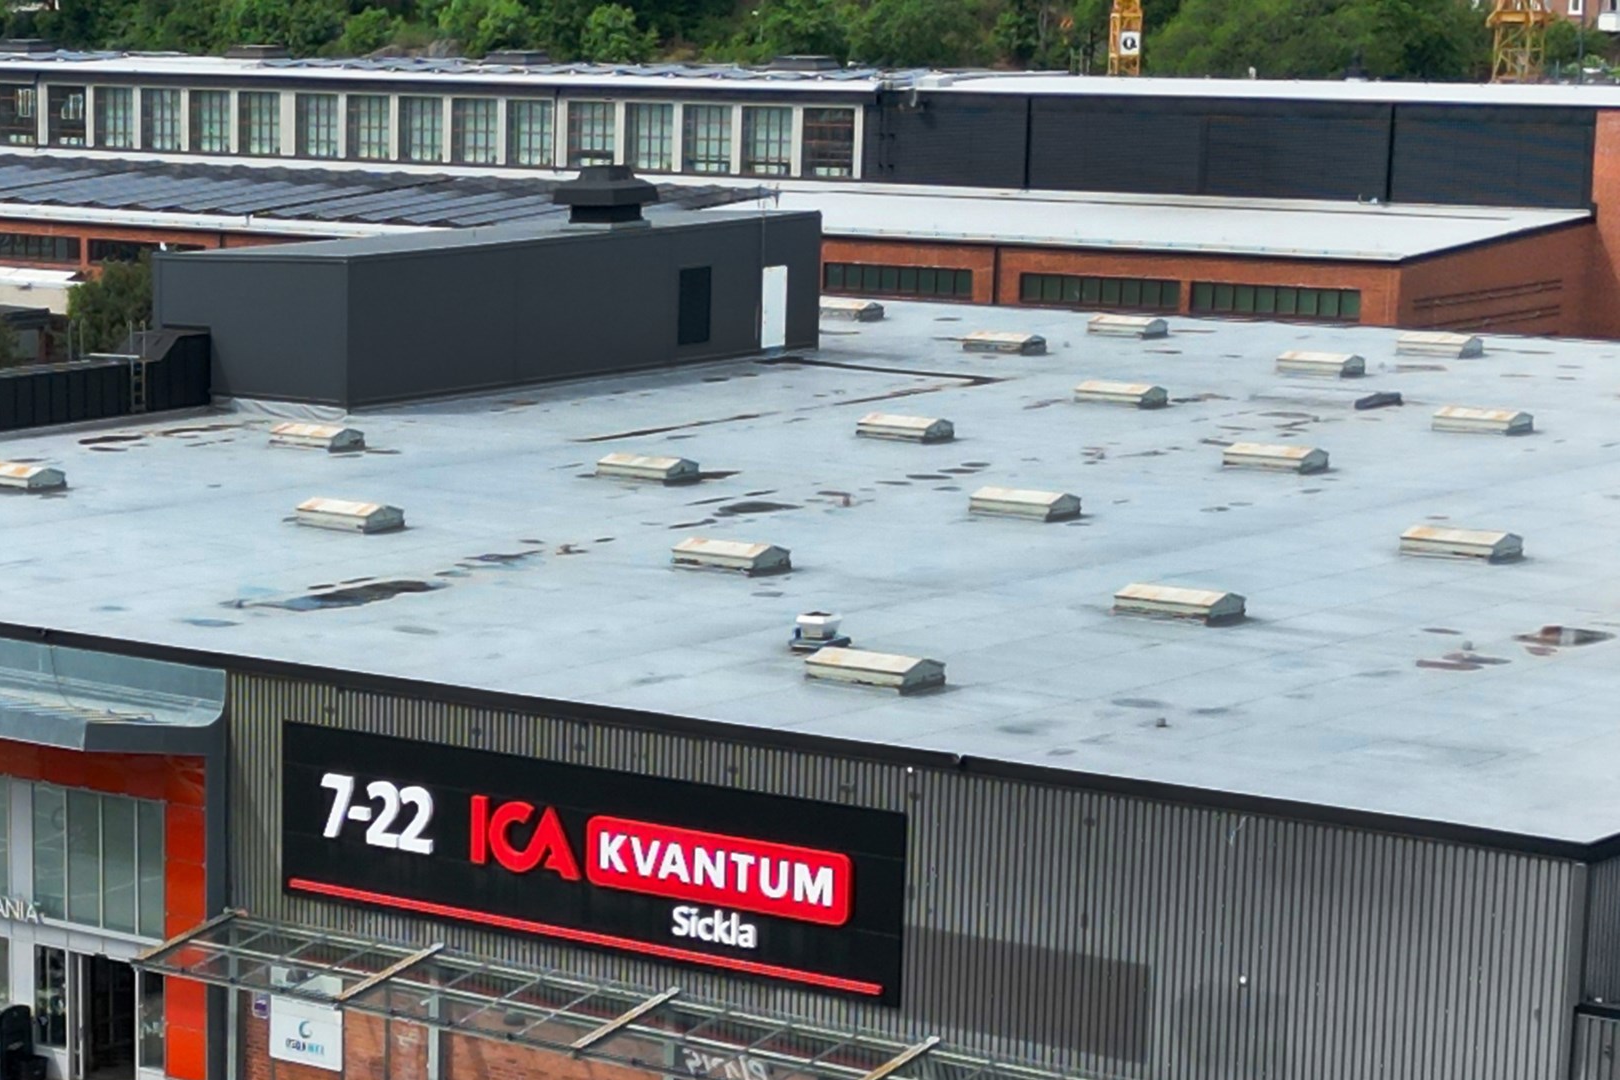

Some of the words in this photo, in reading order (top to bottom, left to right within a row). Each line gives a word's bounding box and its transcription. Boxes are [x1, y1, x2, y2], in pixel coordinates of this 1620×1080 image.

[320, 772, 435, 855] 7-22
[468, 793, 582, 881] ICA
[597, 832, 836, 908] KVANTUM
[671, 904, 757, 949] Sickla
